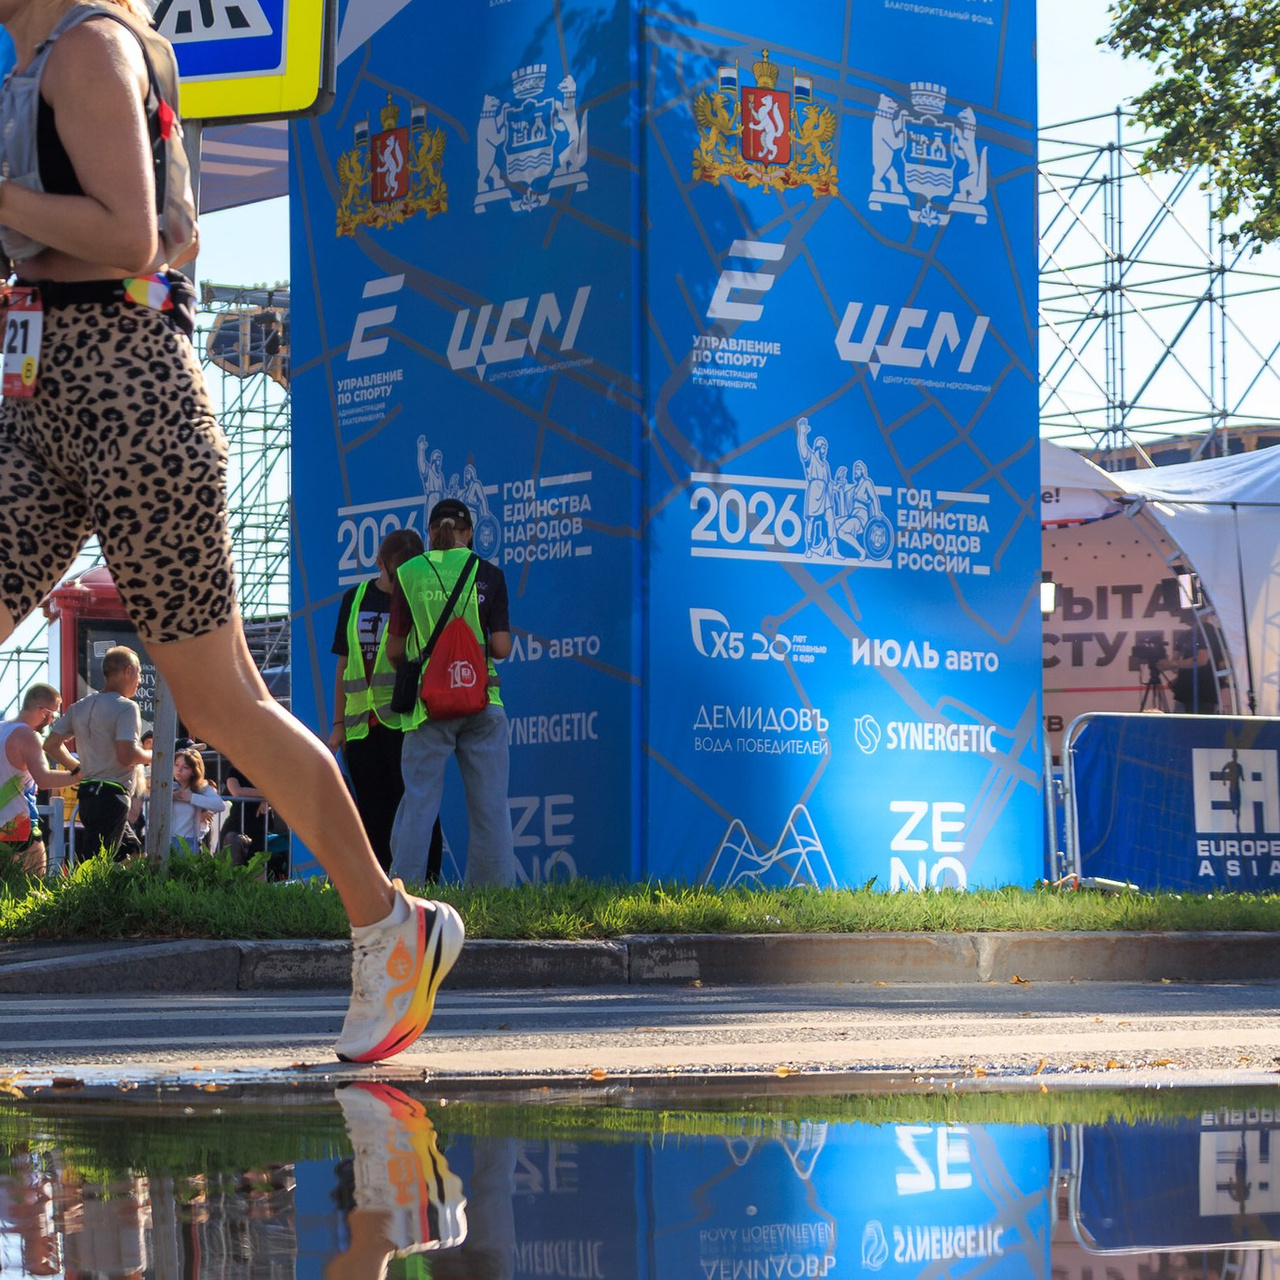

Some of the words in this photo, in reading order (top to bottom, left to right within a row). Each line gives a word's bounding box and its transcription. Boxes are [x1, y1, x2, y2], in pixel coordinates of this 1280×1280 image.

[884, 0, 970, 20] БЛАГОТВОРИТЕЛЬНЫЙ
[971, 14, 994, 25] ФОНД
[692, 335, 781, 355] УПРАВЛЕНИЕ
[692, 350, 712, 363] ПО
[715, 351, 767, 368] СПОРТУ
[337, 369, 404, 391] УПРАВЛЕНИЕ
[692, 367, 758, 379] АДМИНИСТРАЦИЯ
[337, 392, 352, 406] ПО
[353, 385, 393, 402] СПОРТУ
[504, 479, 535, 500] ГОД
[897, 488, 932, 508] ГОД
[504, 494, 591, 522] ЕДИНСТВА
[690, 487, 802, 548] 2026
[504, 519, 583, 543] НАРОДОВ
[897, 509, 990, 533] ЕДИНСТВА
[504, 540, 572, 565] РОССИИ
[897, 531, 981, 553] НАРОДОВ
[897, 552, 970, 574] РОССИИ
[549, 635, 601, 657] авто
[710, 631, 744, 660] X5
[751, 633, 791, 661] 20
[792, 635, 807, 643] лет
[792, 644, 827, 654] главные
[852, 638, 939, 669] ИЮЛЬ
[945, 650, 999, 672] авто
[693, 705, 829, 733] ДЕМИДОВЪ
[695, 737, 733, 753] ВОДА
[736, 738, 829, 755] ПОБЕДИТЕЛЕЙ
[887, 722, 997, 753] SYNERGETIC
[890, 801, 965, 852] ZE
[1197, 840, 1280, 856] EUROPE
[1198, 860, 1280, 876] ASIA
